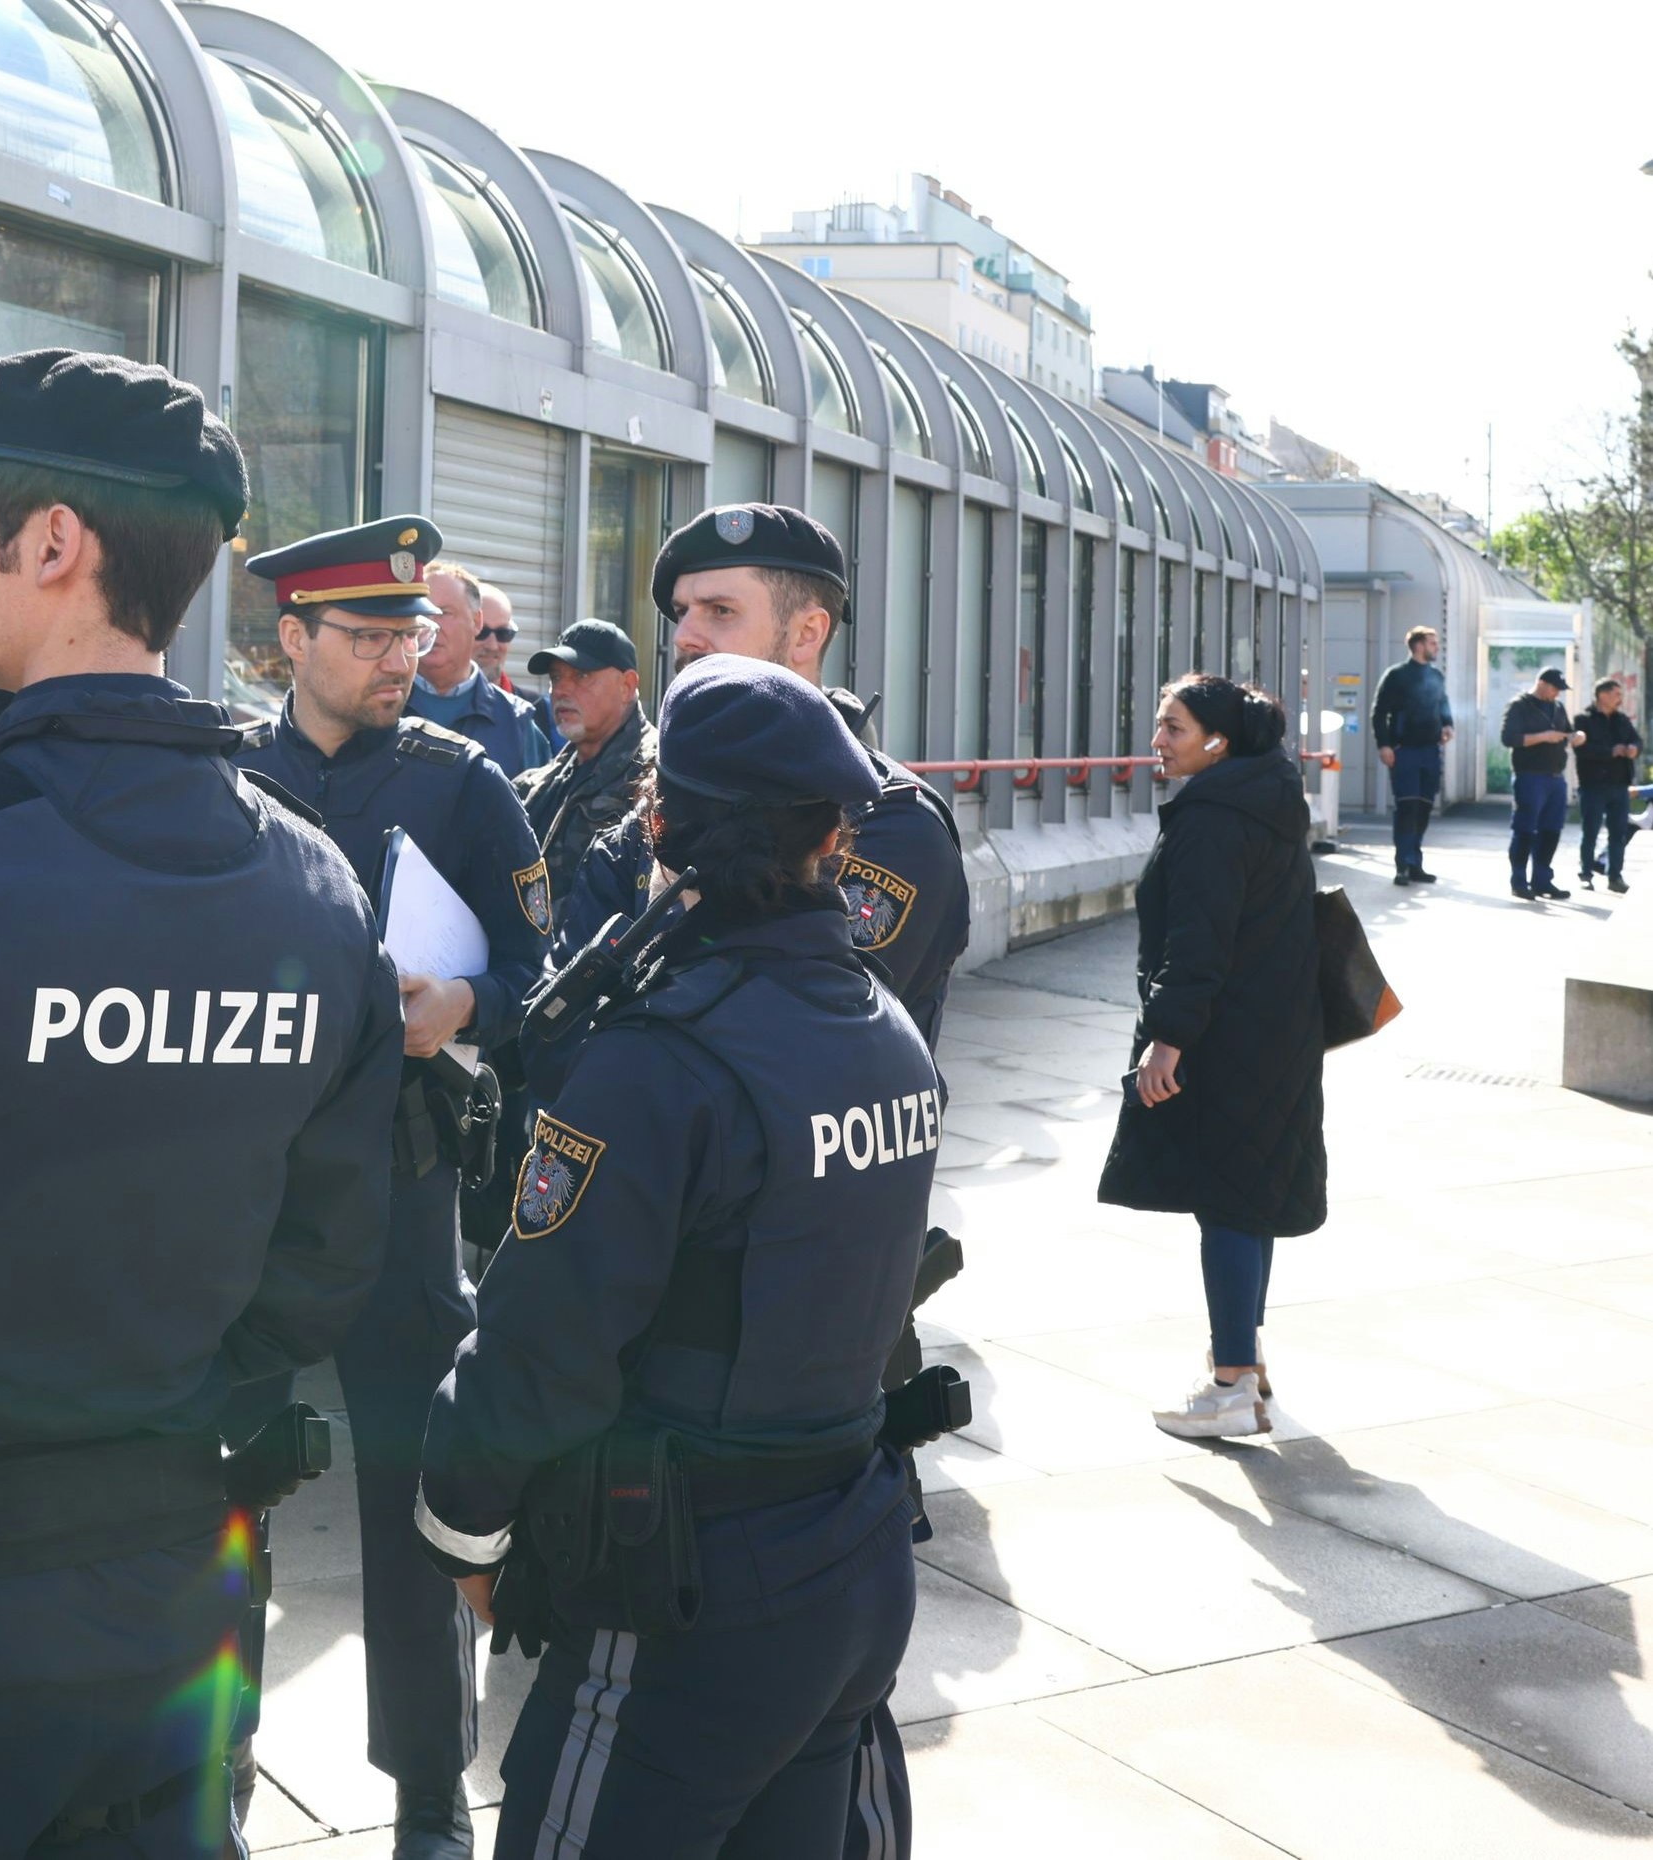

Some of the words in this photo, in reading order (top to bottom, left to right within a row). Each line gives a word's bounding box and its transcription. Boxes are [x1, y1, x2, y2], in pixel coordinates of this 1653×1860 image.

[519, 864, 545, 887] POLIZEI
[848, 862, 910, 903] POLIZEI
[26, 986, 320, 1065] POLIZEI
[537, 1121, 594, 1165] POLIZEI
